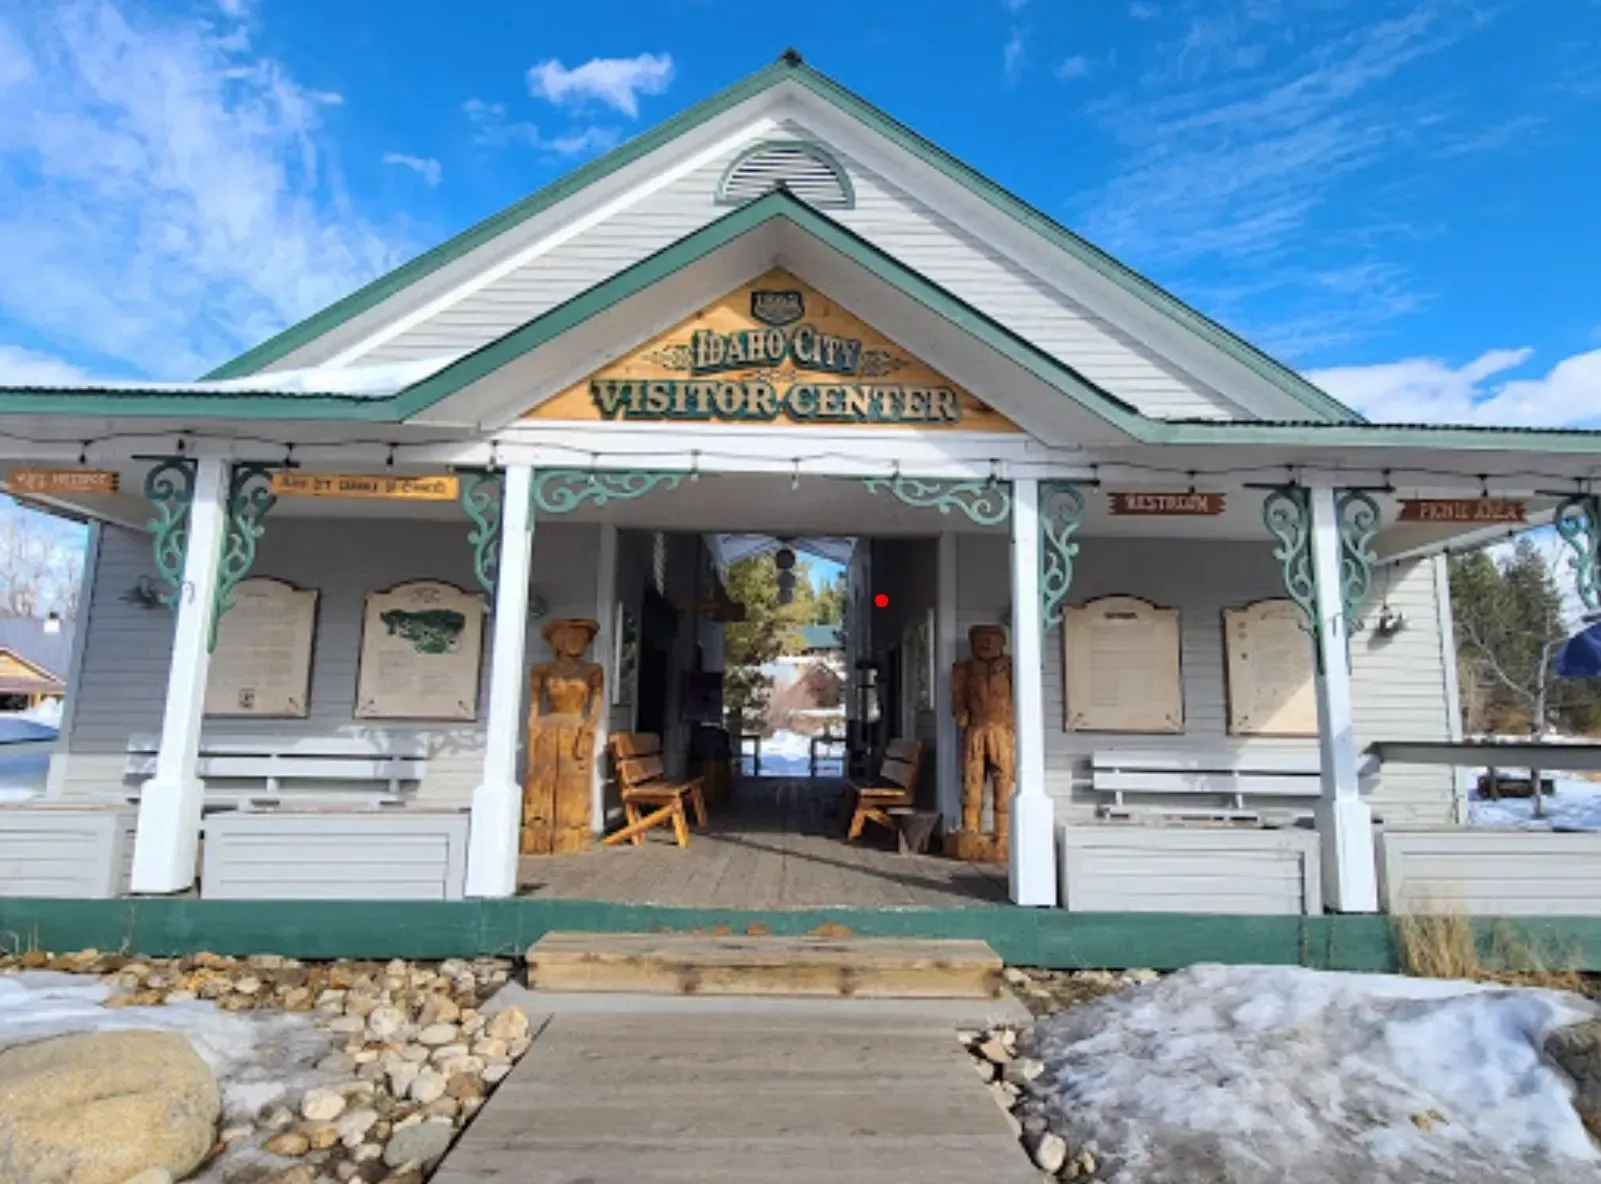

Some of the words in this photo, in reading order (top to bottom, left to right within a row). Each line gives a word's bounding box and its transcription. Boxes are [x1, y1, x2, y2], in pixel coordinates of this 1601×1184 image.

[693, 327, 786, 368] IDAHO
[793, 327, 861, 371] CITY
[595, 381, 777, 416] VISITOR
[789, 384, 958, 421] CENTER
